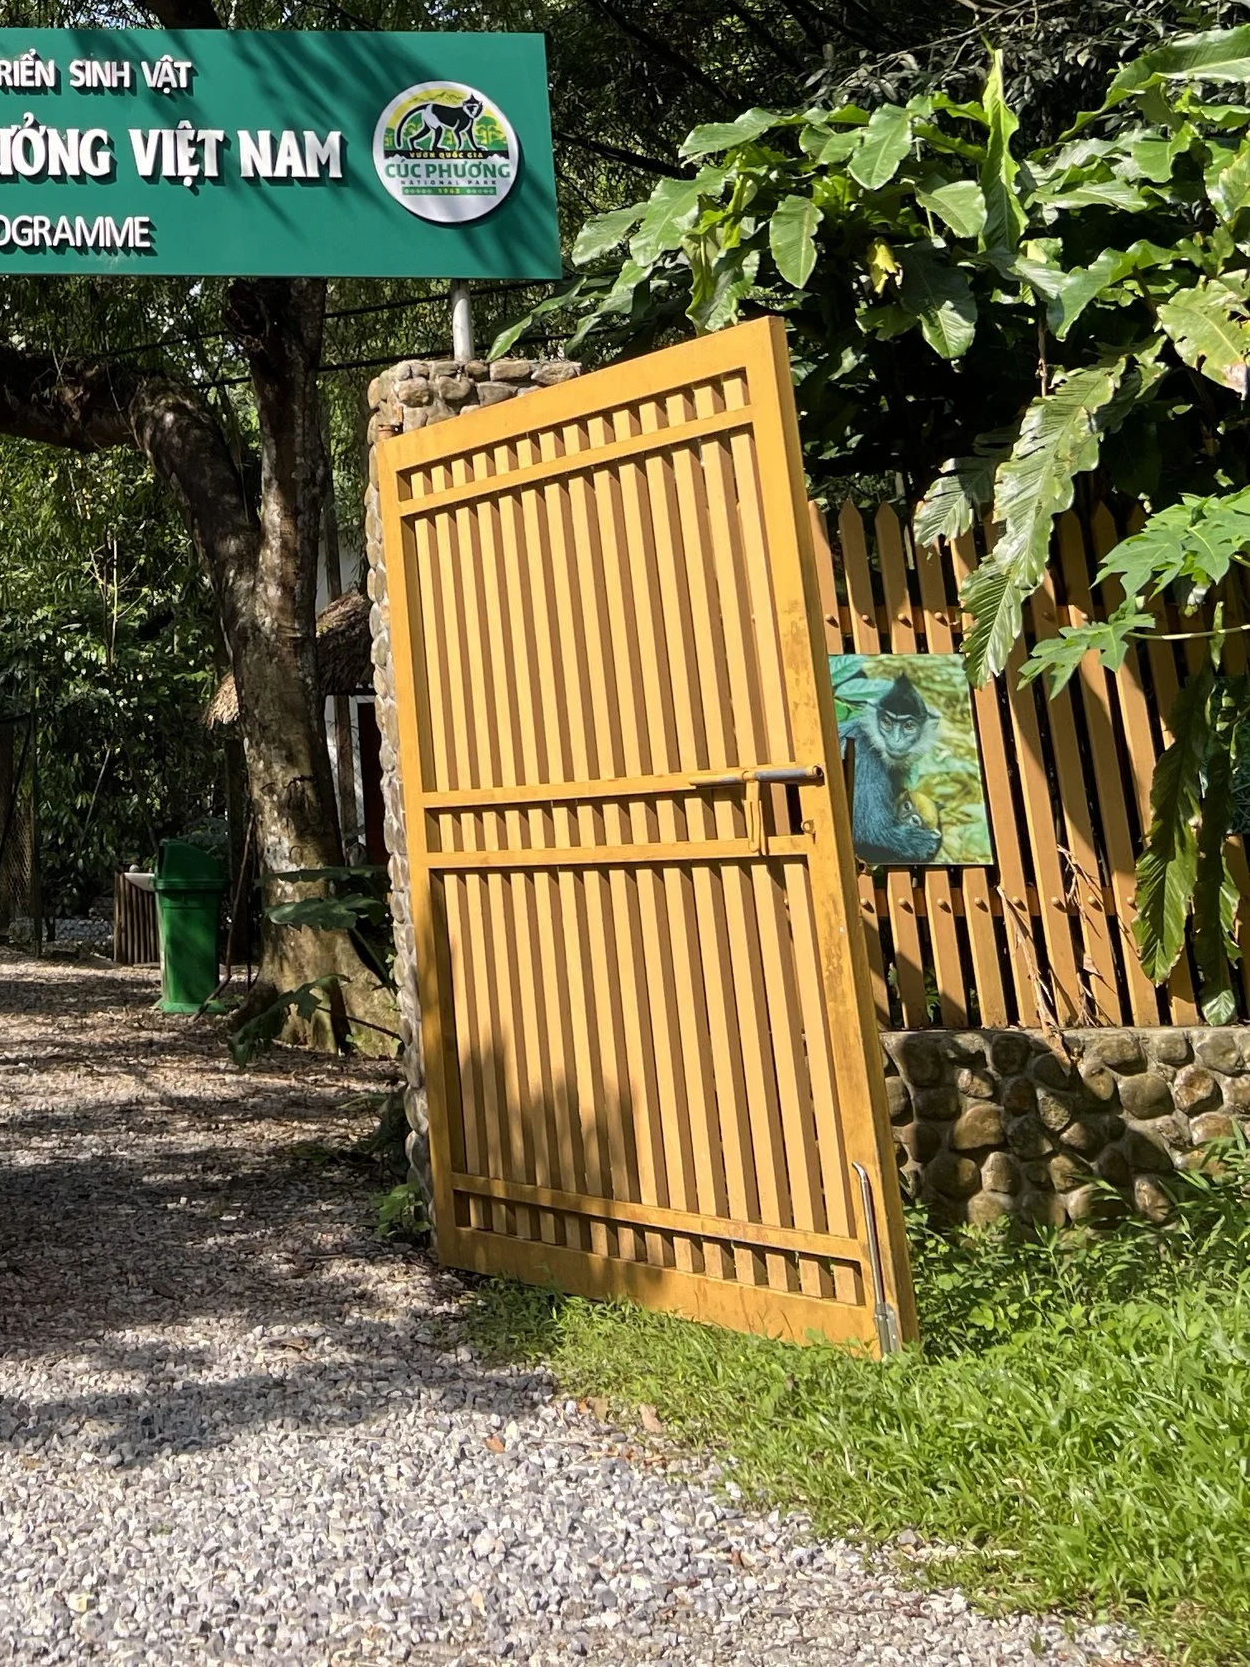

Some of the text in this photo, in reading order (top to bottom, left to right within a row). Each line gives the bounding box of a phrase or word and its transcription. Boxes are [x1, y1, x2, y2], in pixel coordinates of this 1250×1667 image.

[69, 61, 130, 88] SINH
[141, 54, 192, 94] VẬT
[128, 119, 225, 187] VIỆT
[237, 129, 343, 178] NAM
[385, 158, 510, 179] CÚC PHƯƠNG
